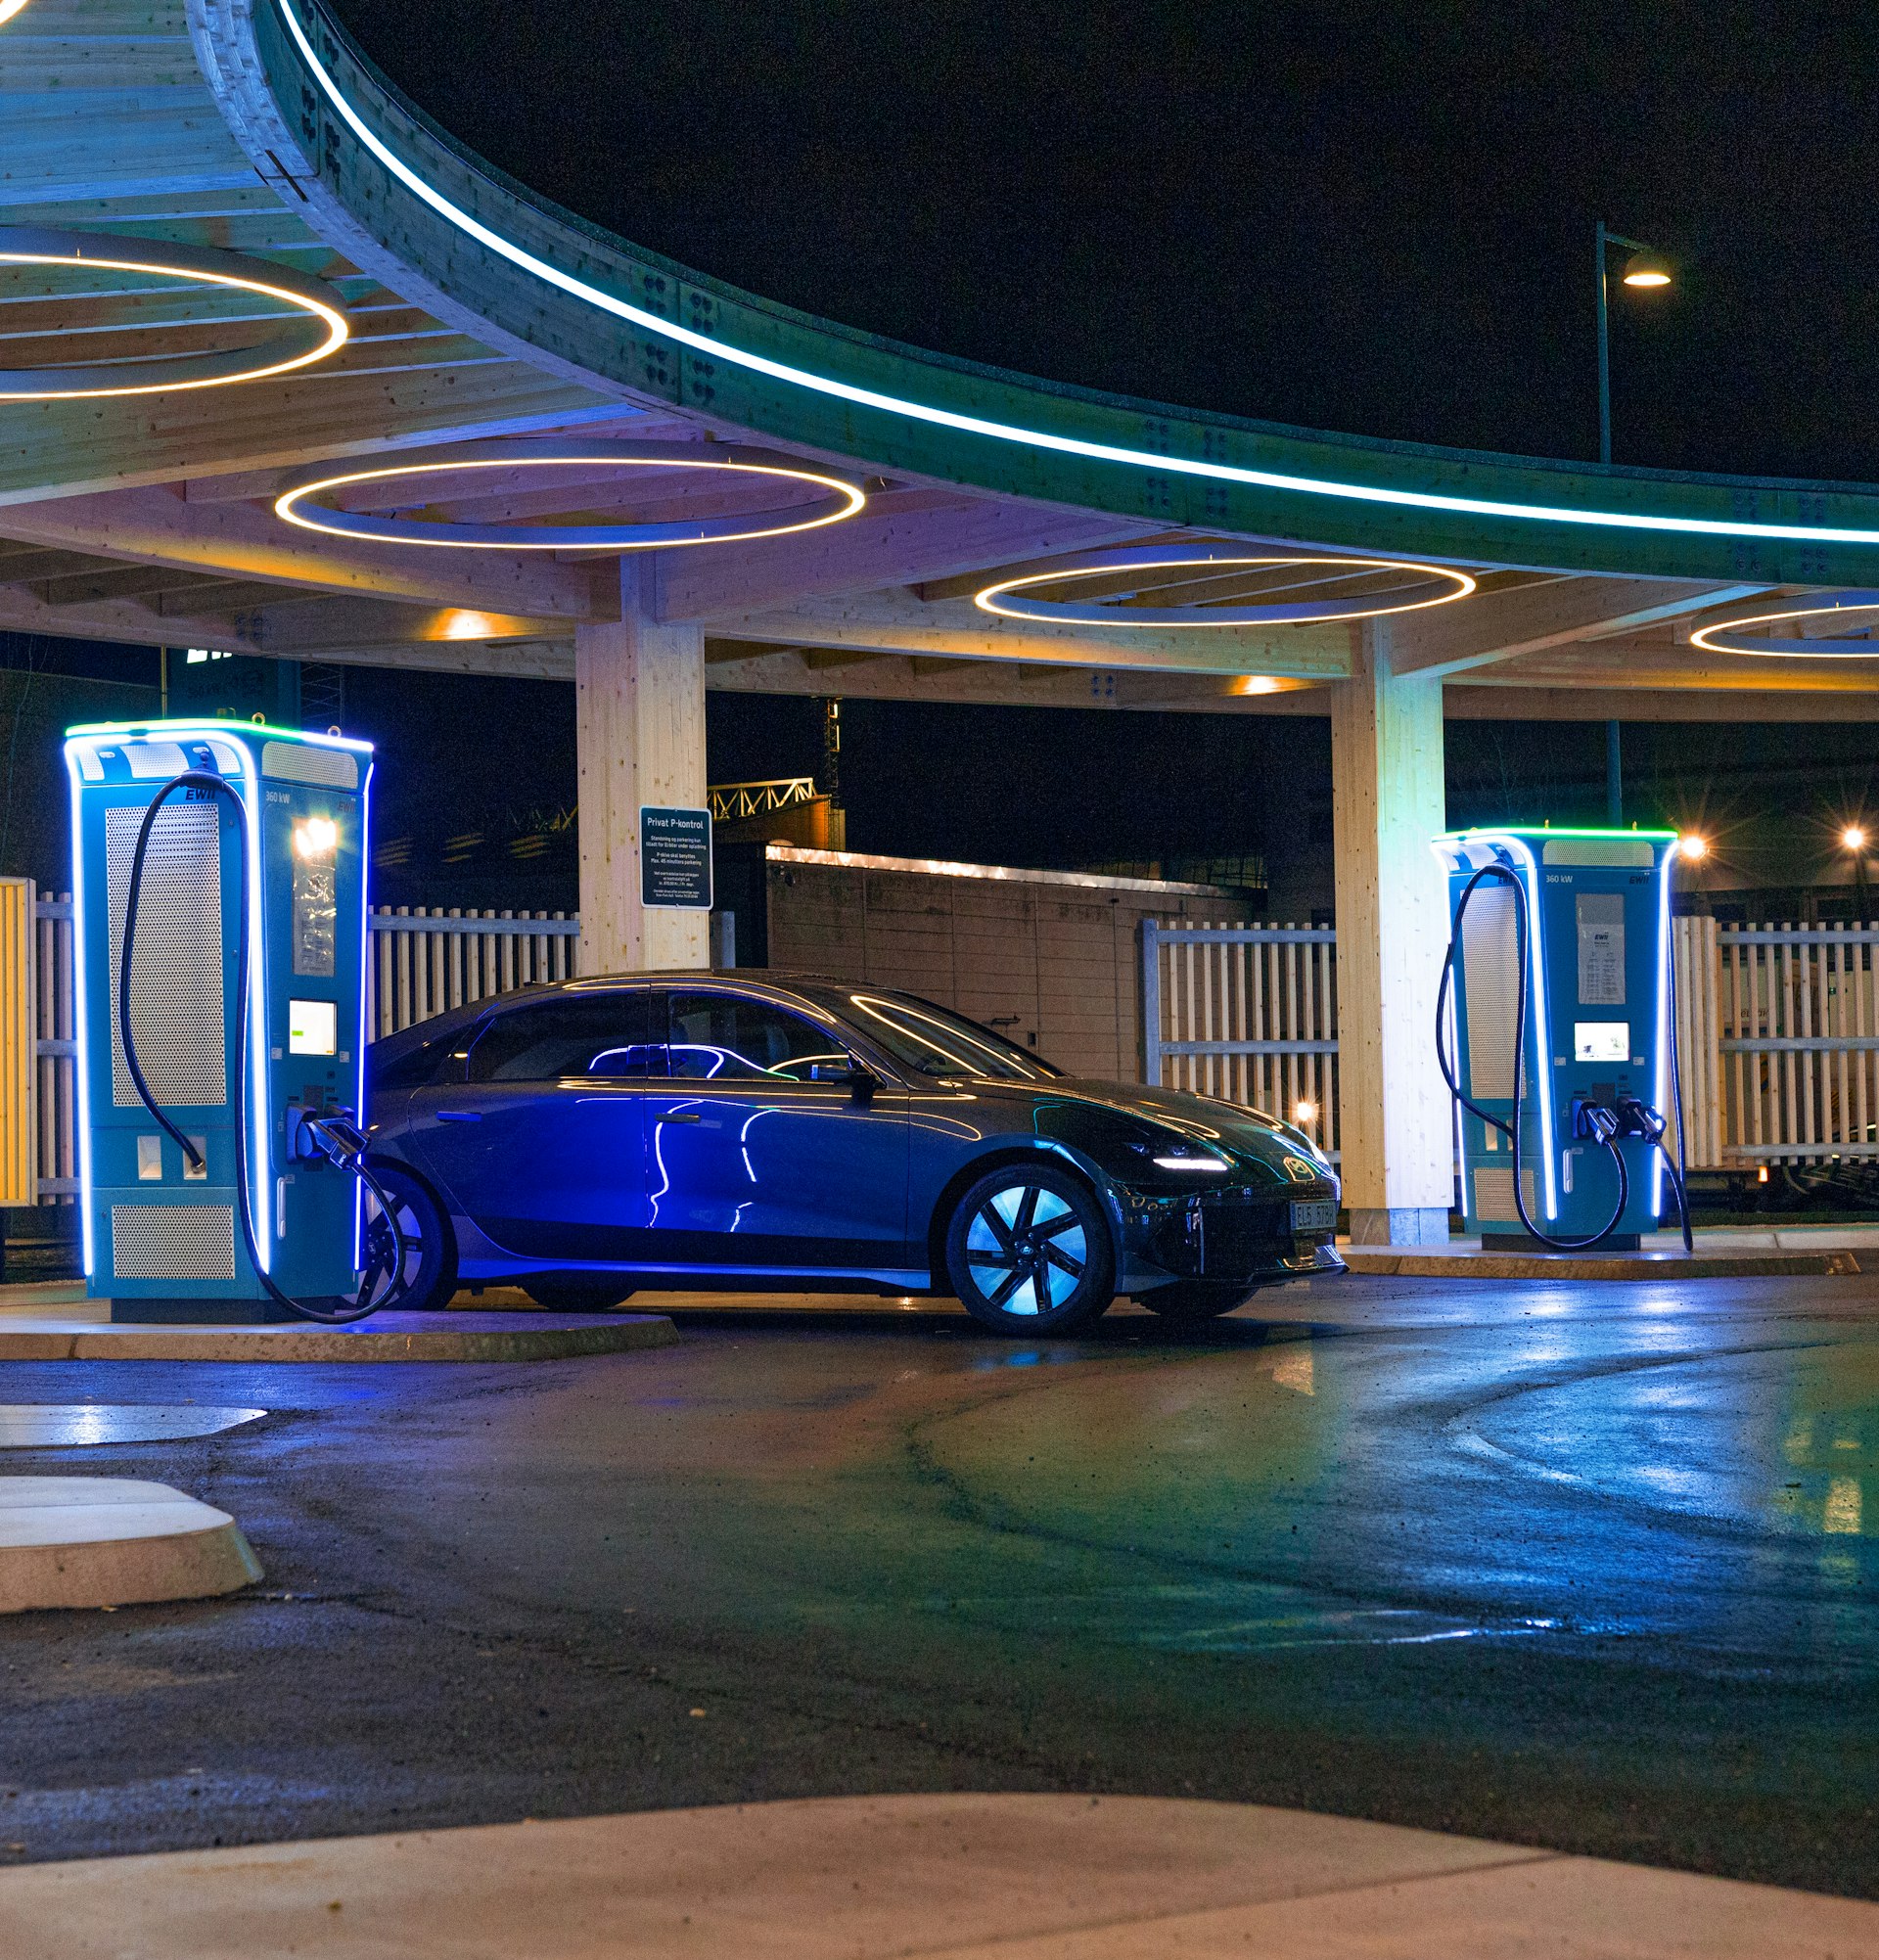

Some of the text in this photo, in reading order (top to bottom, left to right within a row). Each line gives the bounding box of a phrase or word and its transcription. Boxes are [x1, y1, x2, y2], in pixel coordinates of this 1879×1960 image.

[265, 791, 291, 804] 360 kW
[647, 817, 704, 829] Privat P-kontrol
[1545, 875, 1573, 884] 360 kW
